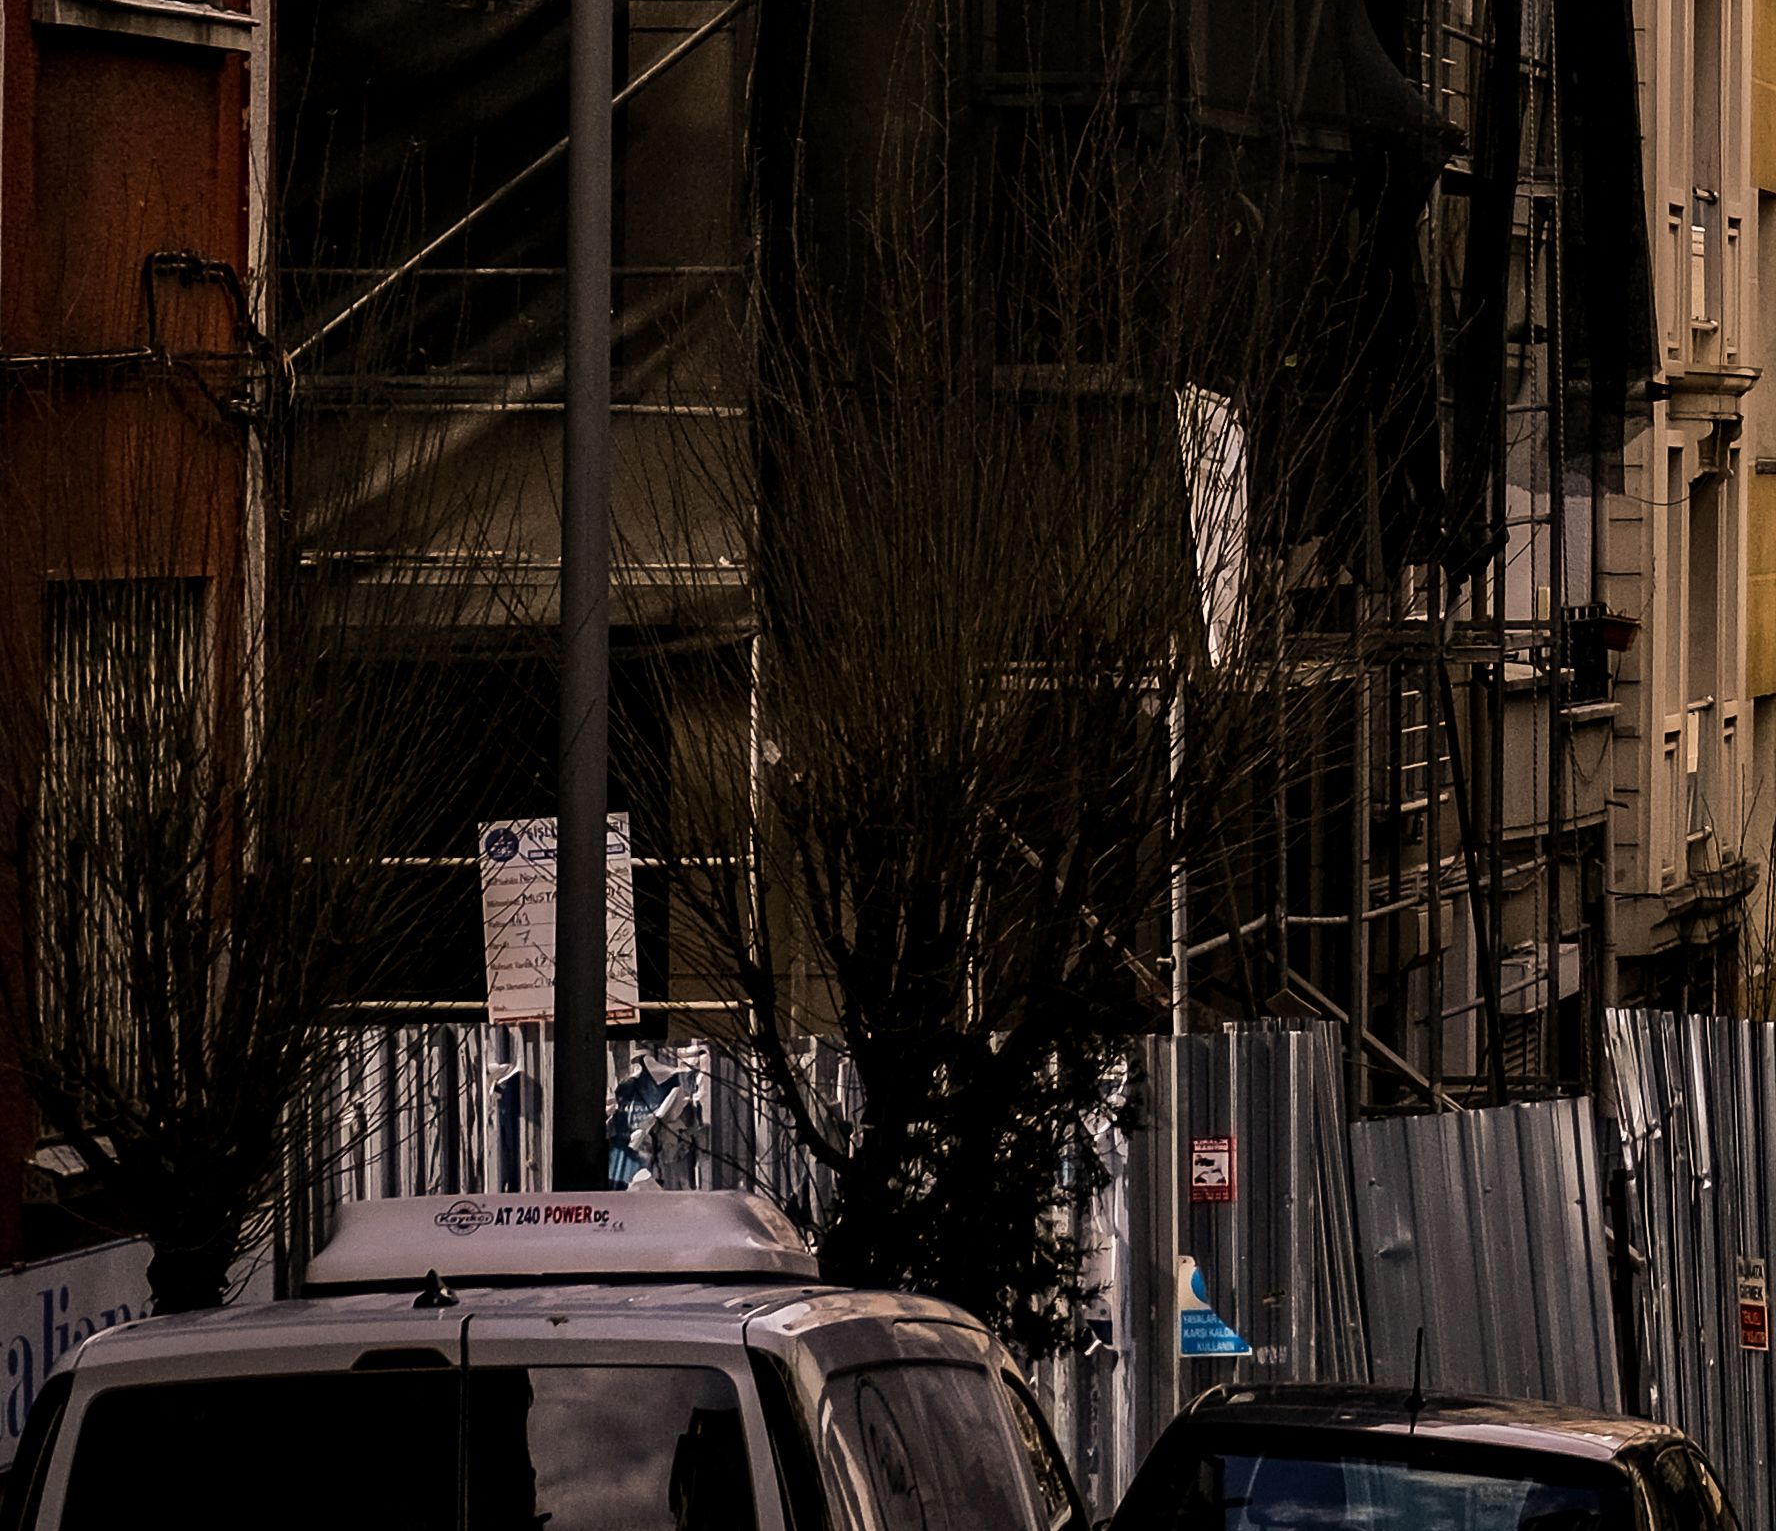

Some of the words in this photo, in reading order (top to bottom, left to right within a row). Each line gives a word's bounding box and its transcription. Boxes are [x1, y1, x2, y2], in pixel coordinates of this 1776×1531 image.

[495, 1208, 512, 1225] AT
[516, 1207, 540, 1224] 240
[543, 1206, 592, 1223] POWER
